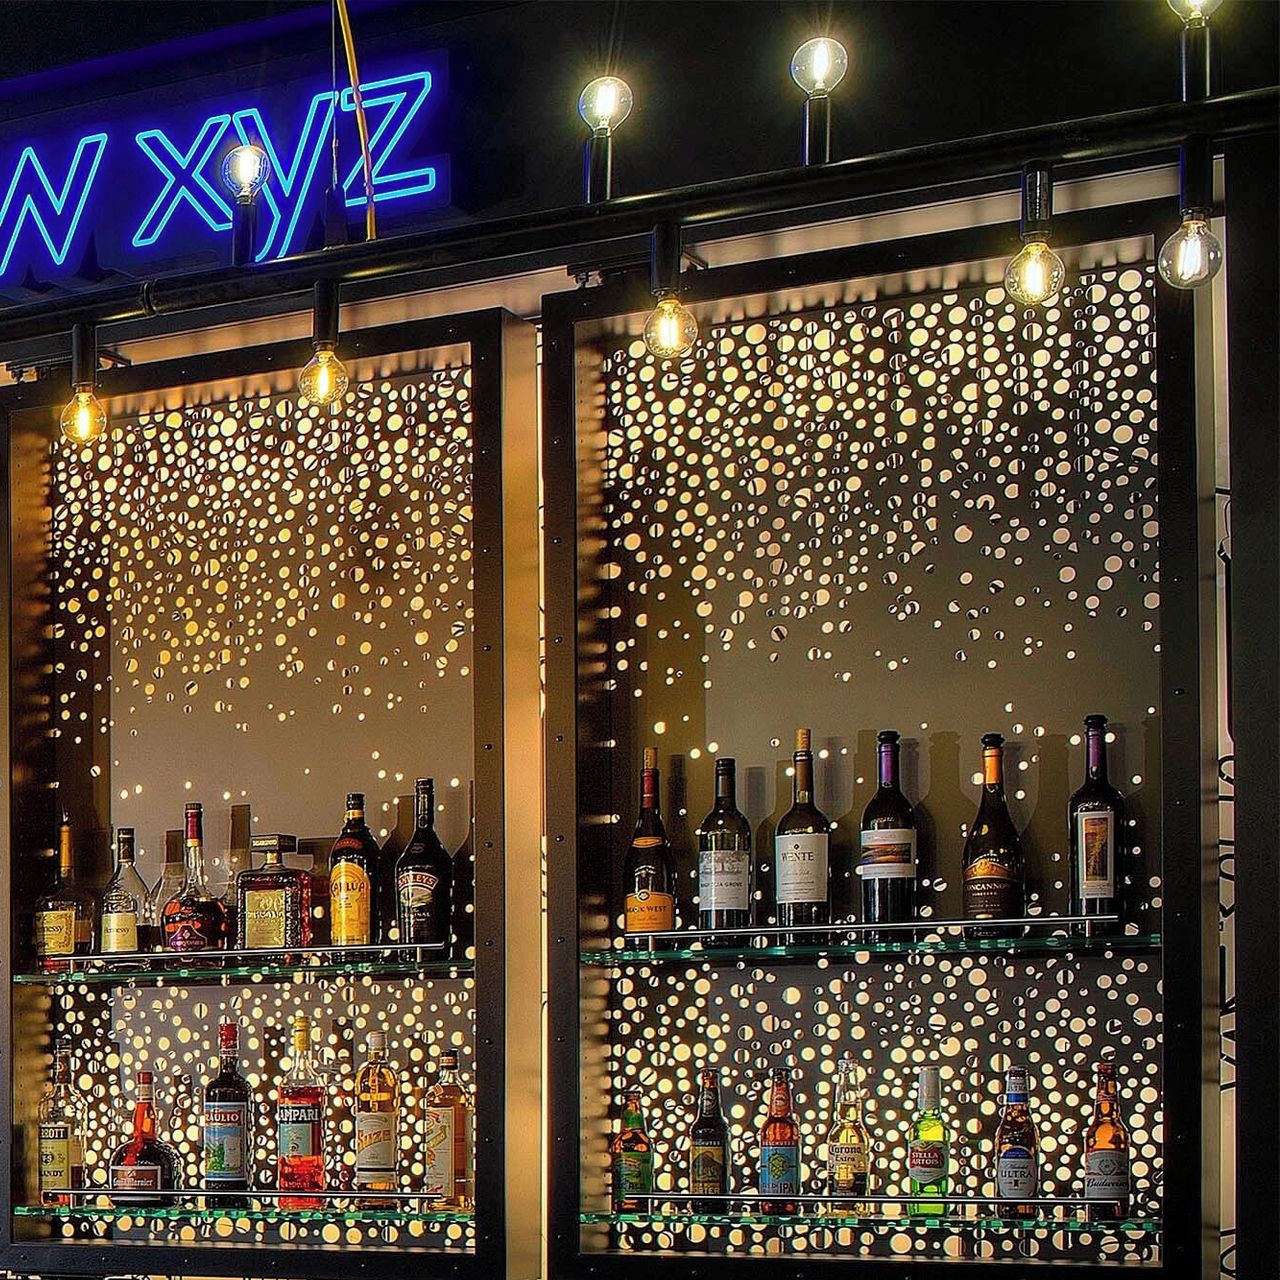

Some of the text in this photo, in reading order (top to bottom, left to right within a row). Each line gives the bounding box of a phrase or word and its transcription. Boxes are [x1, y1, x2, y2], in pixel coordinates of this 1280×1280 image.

[781, 851, 815, 862] WENTE
[830, 1144, 862, 1154] Corona
[1000, 1170, 1032, 1178] ULTRA
[779, 1182, 794, 1193] IPA
